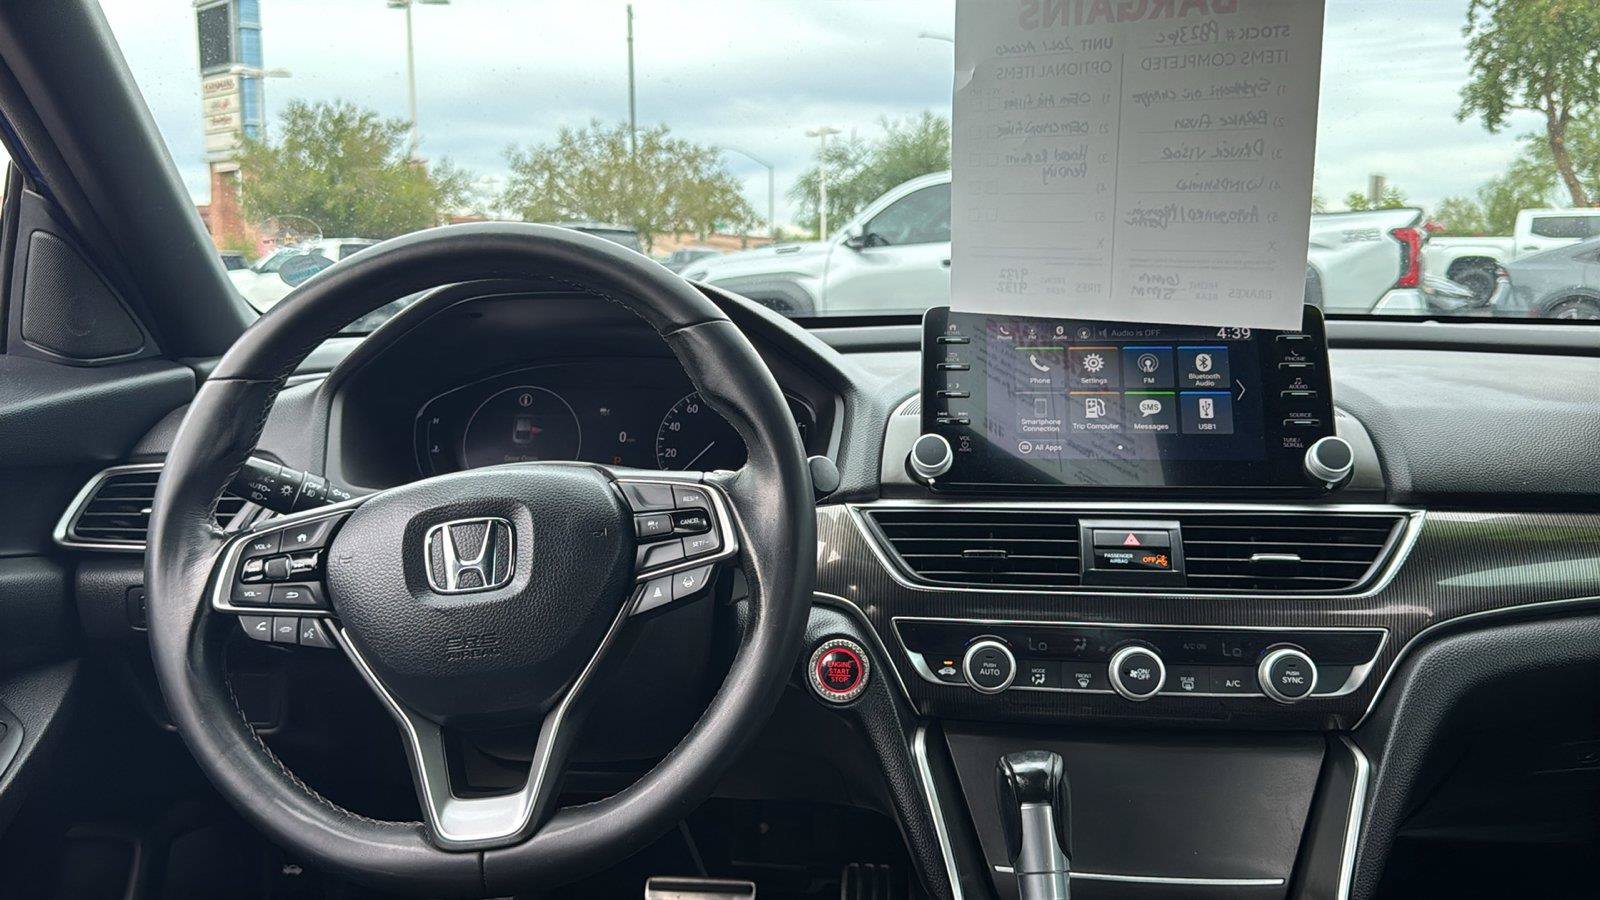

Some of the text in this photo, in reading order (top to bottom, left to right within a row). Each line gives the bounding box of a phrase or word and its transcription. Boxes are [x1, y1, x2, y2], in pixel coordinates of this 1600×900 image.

[1111, 328, 1134, 337] Audio
[1145, 328, 1161, 337] OFF
[1216, 326, 1251, 339] 4:39
[1030, 377, 1051, 385] Phone
[1081, 377, 1108, 386] Settings
[1188, 373, 1221, 381] Bluetooth
[686, 404, 698, 413] 60
[1141, 403, 1159, 411] SMS
[669, 422, 681, 432] 40
[1021, 418, 1061, 427] Smartphone
[1073, 422, 1119, 431] Trip Computer
[1134, 423, 1169, 432] Messages
[619, 431, 627, 443] 0
[1045, 444, 1062, 452] Apps
[665, 448, 677, 458] 20
[680, 517, 701, 526] CANCEL
[828, 661, 852, 669] ENGINE
[979, 668, 1001, 677] AUTO
[1281, 676, 1304, 684] SYNC
